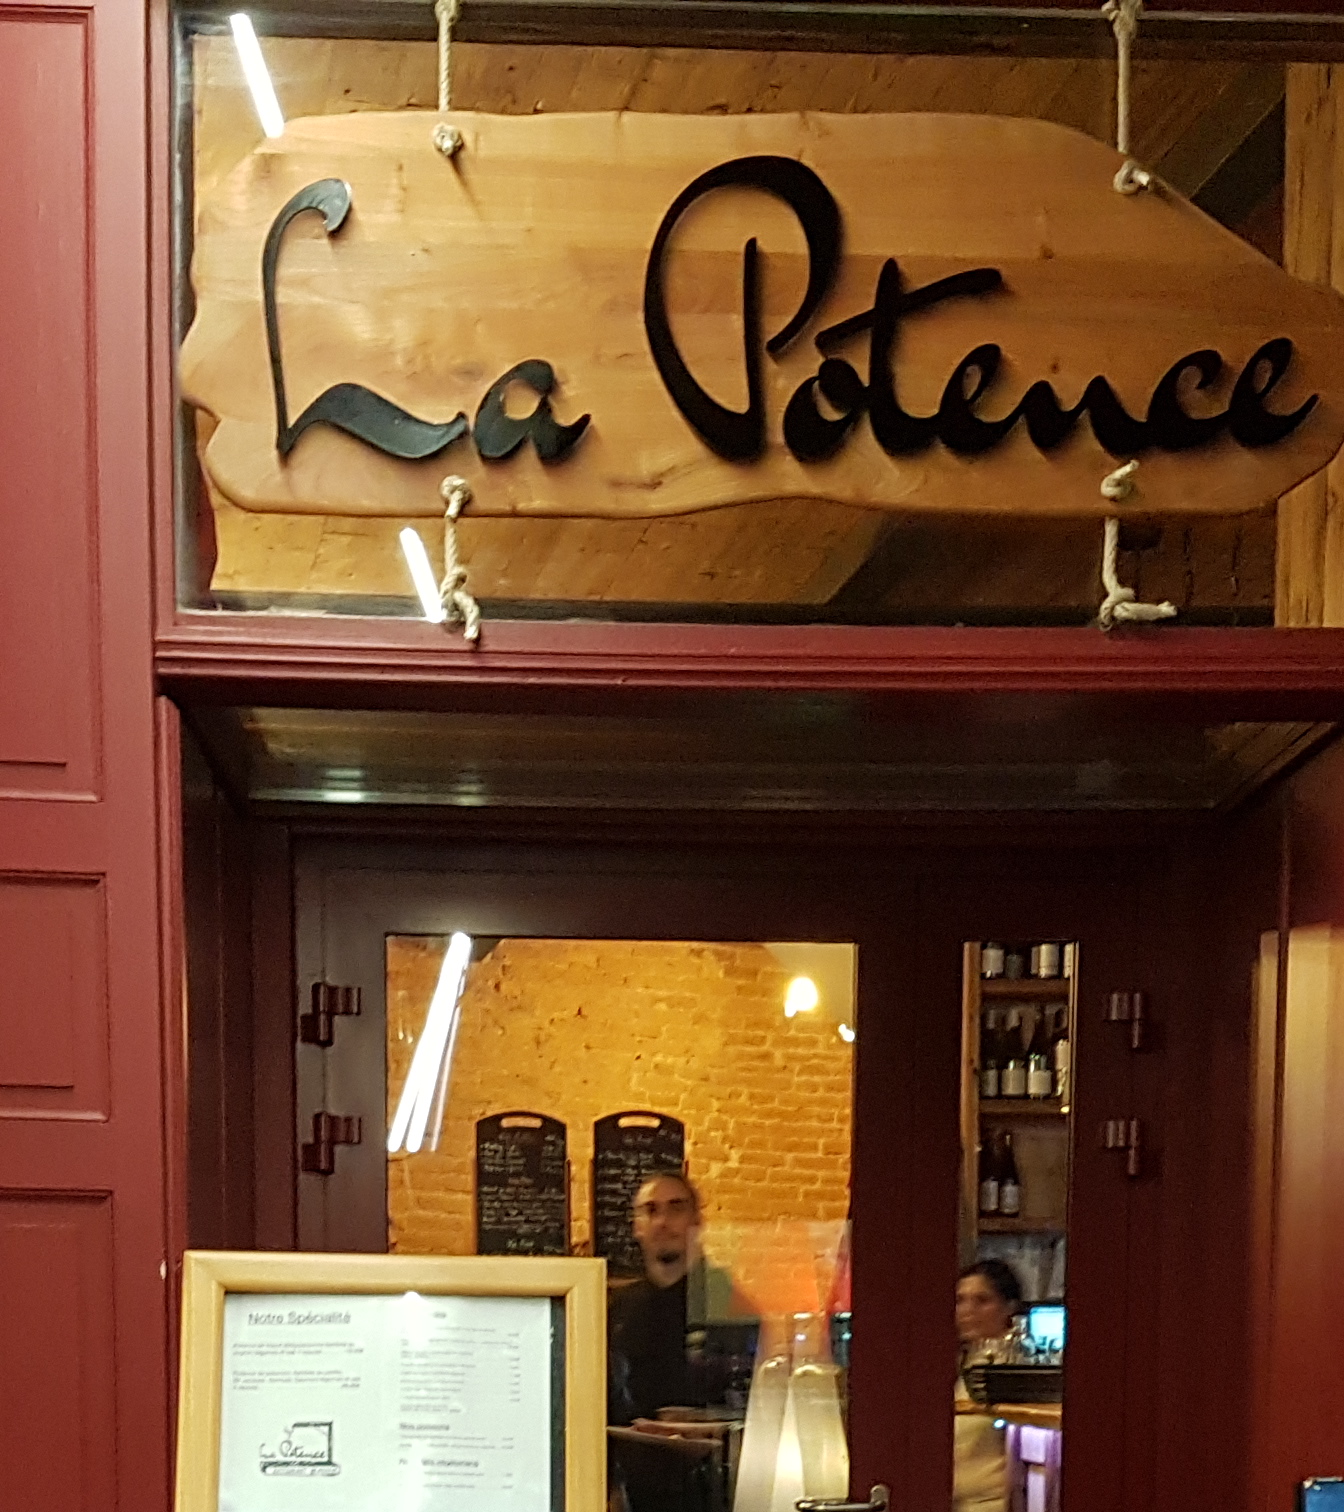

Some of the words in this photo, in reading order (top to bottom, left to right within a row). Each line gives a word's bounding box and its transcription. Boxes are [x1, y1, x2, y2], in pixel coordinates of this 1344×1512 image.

[261, 177, 592, 464] La
[643, 155, 1320, 463] Potence
[248, 1312, 284, 1325] Notre
